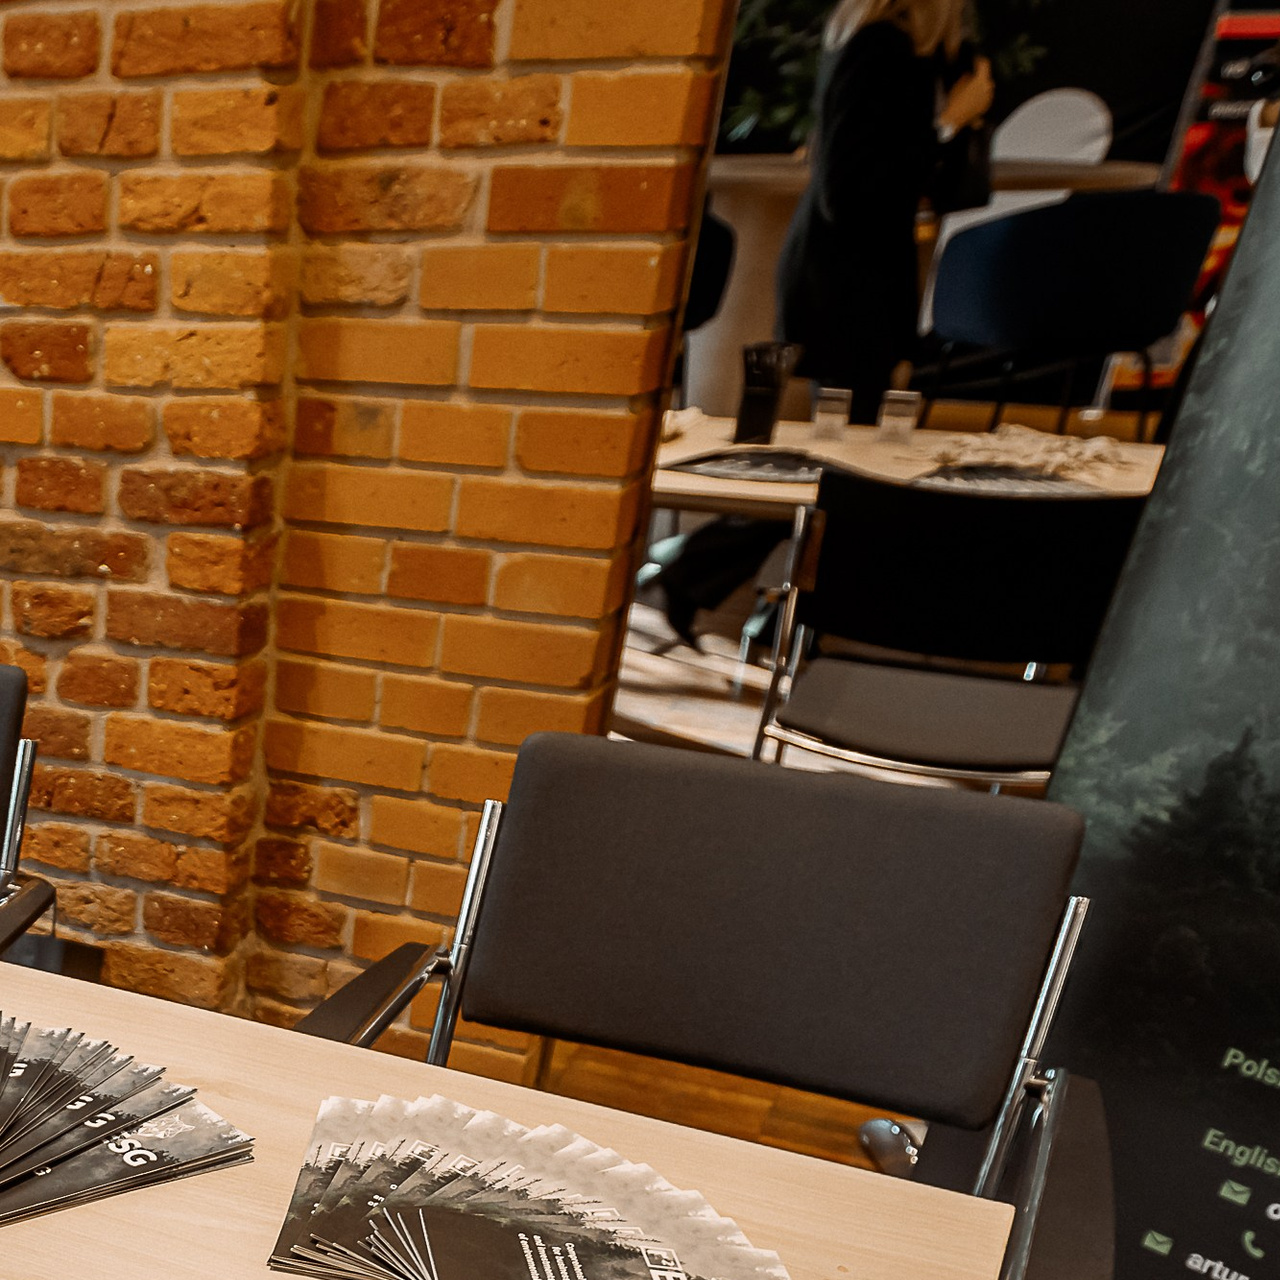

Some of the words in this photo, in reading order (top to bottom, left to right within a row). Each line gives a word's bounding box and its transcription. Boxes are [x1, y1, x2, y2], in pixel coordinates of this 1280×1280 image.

[1222, 1047, 1280, 1088] Pols
[1203, 1127, 1280, 1176] Englis
[533, 1235, 546, 1246] and
[552, 1246, 562, 1255] for
